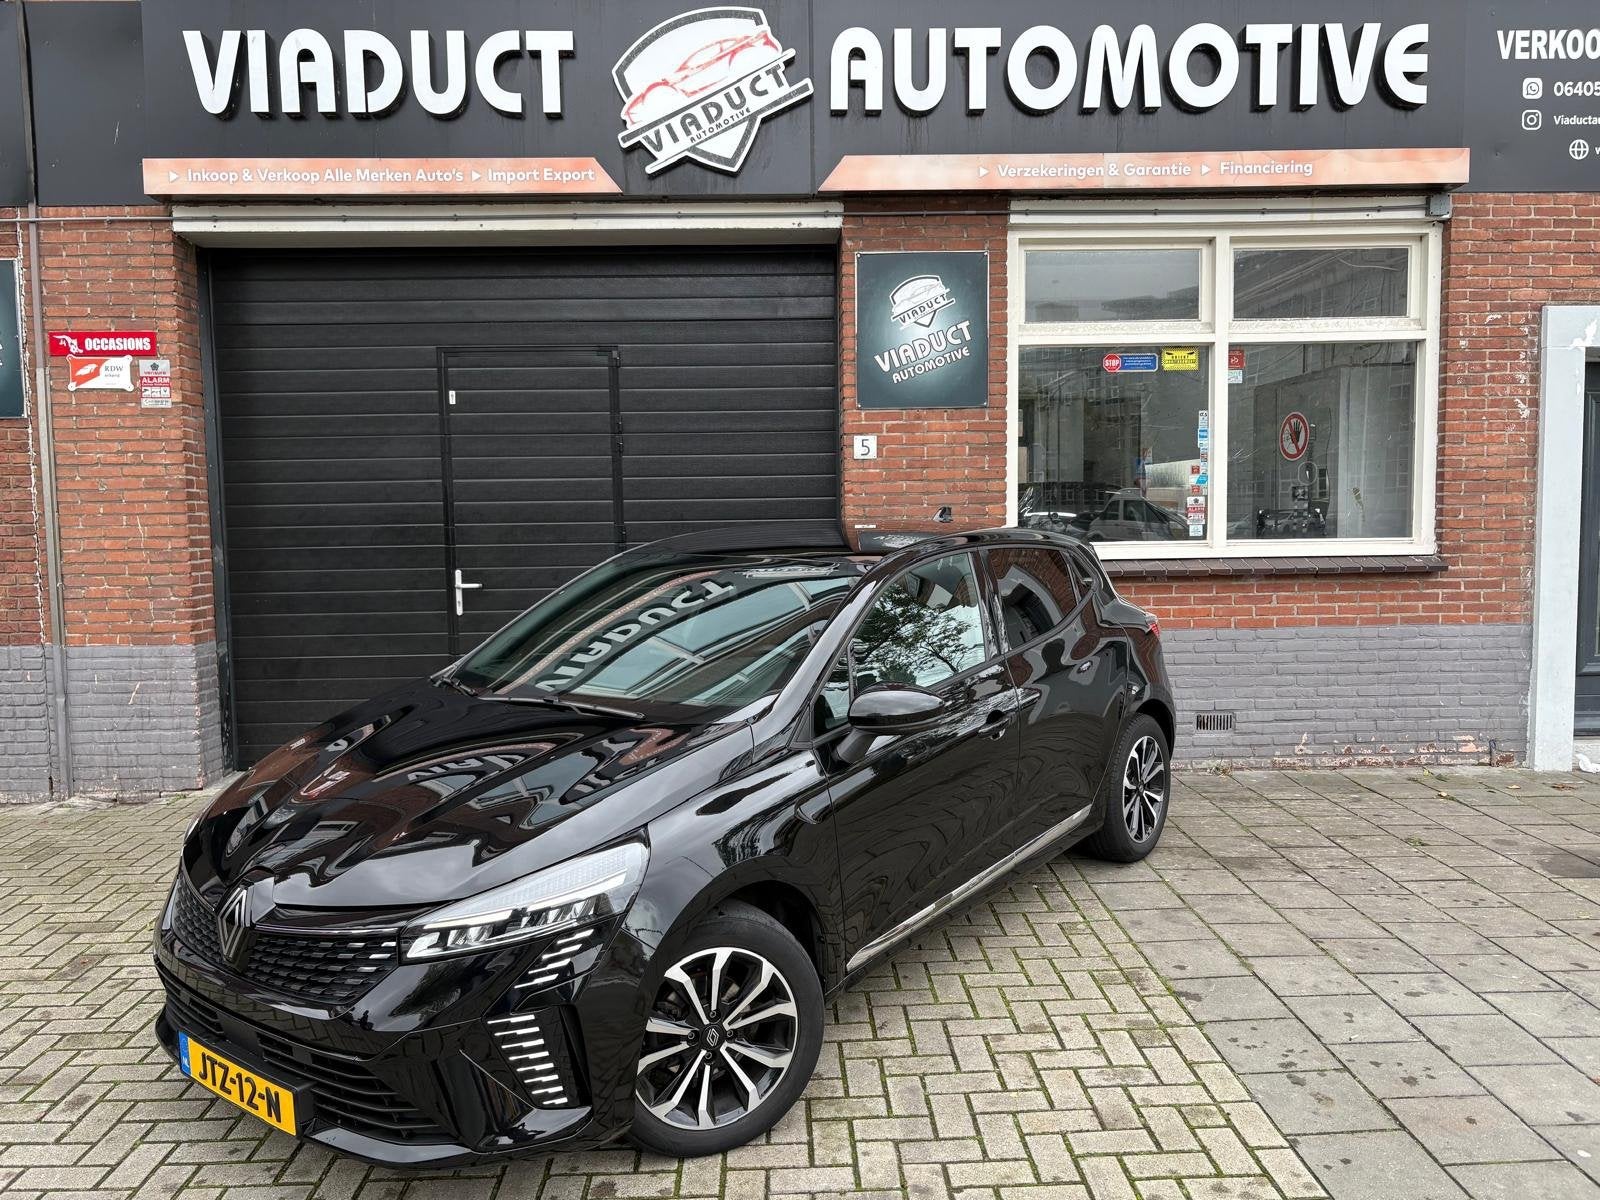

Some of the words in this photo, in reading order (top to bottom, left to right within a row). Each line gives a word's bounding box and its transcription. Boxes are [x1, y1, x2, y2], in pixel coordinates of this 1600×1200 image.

[182, 28, 575, 115] VIADUCT
[830, 23, 1429, 111] AUTOMOTIVE
[642, 64, 786, 153] VIADUCT
[690, 107, 751, 144] AUTOMOTIVE
[187, 168, 239, 184] Inkoop
[242, 168, 254, 181] &
[256, 168, 321, 184] Verkoop
[324, 168, 353, 181] Alle
[356, 168, 412, 182] Merken
[415, 168, 464, 182] Auto's
[488, 168, 541, 184] Import
[543, 168, 596, 184] Export
[998, 164, 1104, 180] Verzekeringen
[1108, 164, 1119, 177] &
[1123, 163, 1192, 177] Garantie
[1219, 160, 1313, 176] Financiering
[898, 293, 947, 324] VIADUCT
[84, 337, 152, 351] OCCASIONS
[874, 320, 973, 373] VIADUCT
[892, 346, 971, 384] AUTOMOTIVE
[1104, 359, 1120, 367] STOP
[860, 438, 870, 456] 5
[198, 1051, 282, 1124] JTZ-12-N
